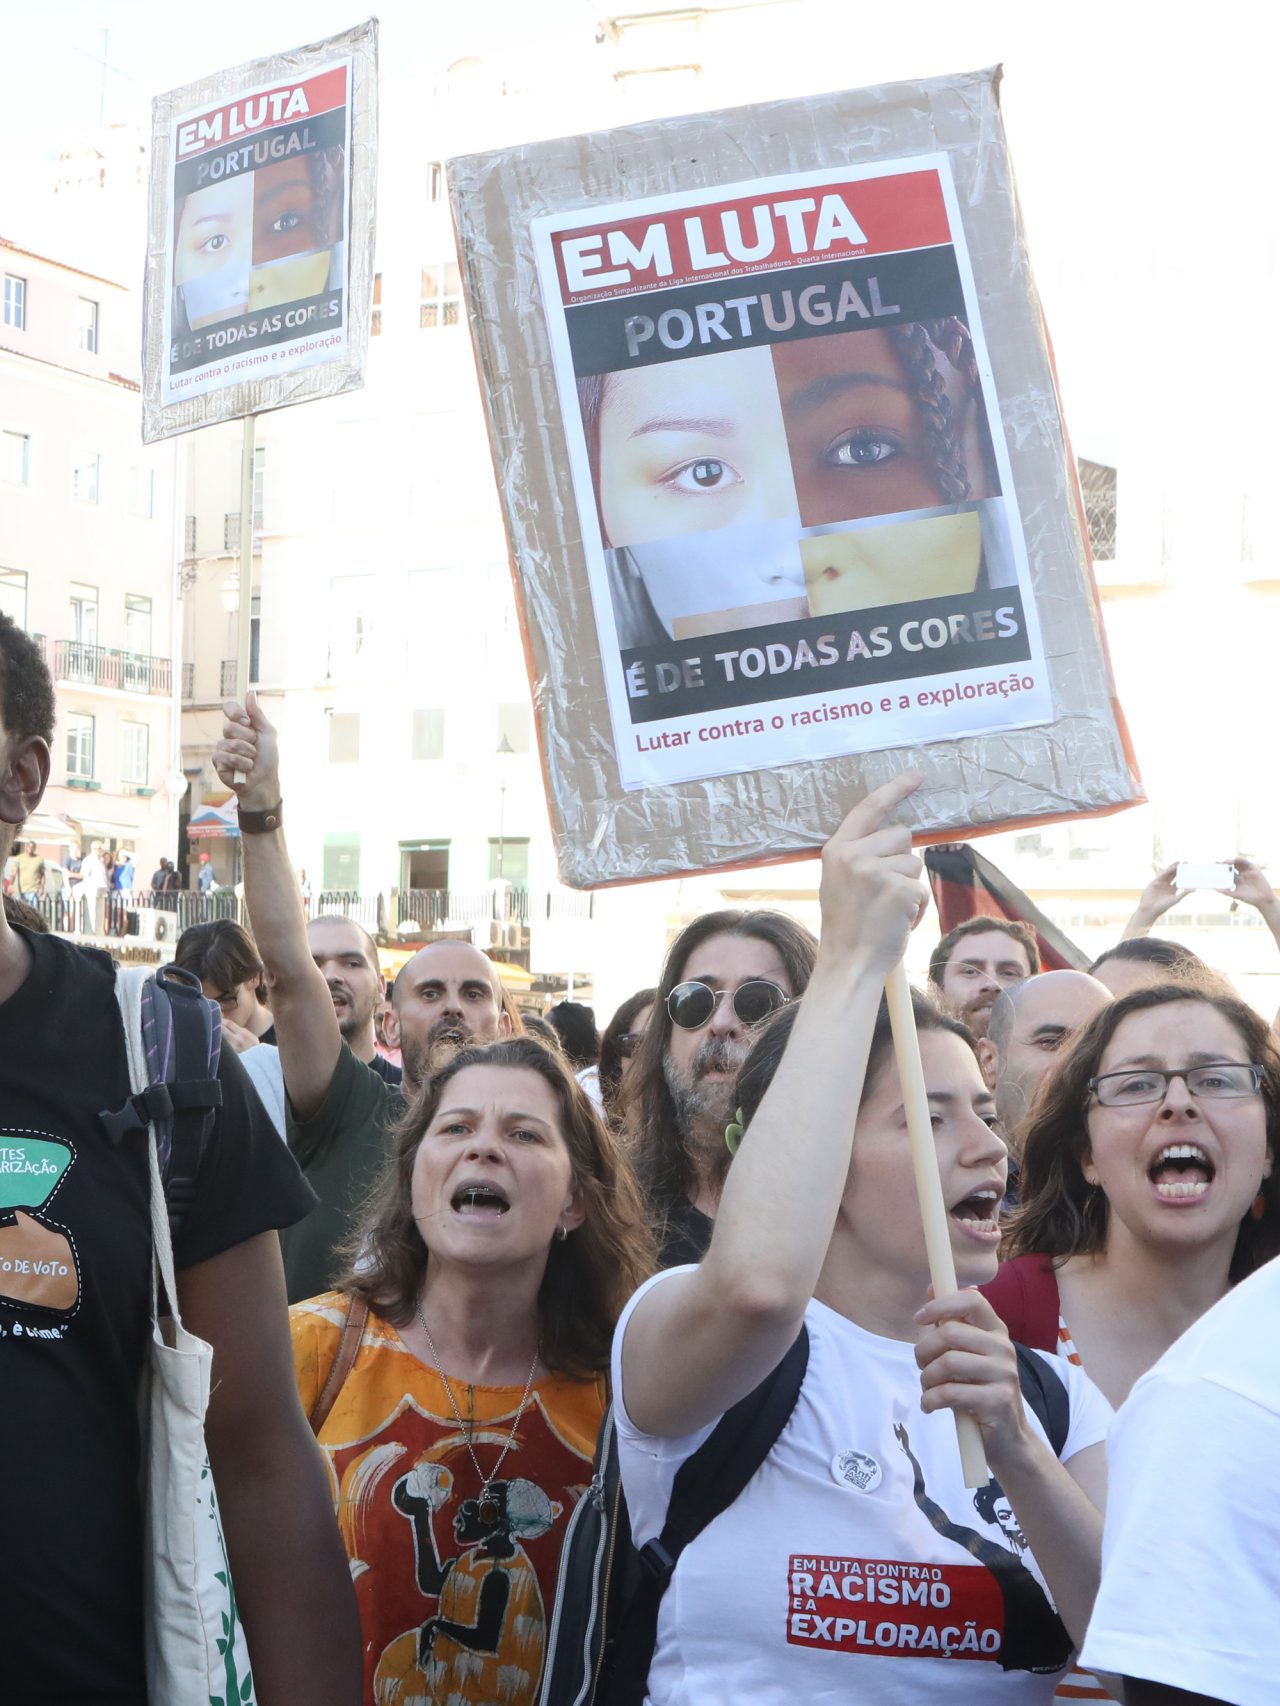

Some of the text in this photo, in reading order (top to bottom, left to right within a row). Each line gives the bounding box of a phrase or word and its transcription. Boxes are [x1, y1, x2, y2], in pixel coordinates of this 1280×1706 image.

[178, 112, 223, 155] EM
[229, 88, 309, 136] LUTA
[197, 128, 316, 185] PORTUGAL
[561, 194, 868, 293] EM LUTA
[570, 289, 613, 303] Organização
[613, 283, 657, 296] Simpatizante
[659, 279, 667, 287] da
[669, 276, 684, 287] Liga
[685, 269, 730, 282] Internacional
[731, 267, 744, 275] dos
[745, 259, 791, 273] Trabalhadores
[796, 255, 820, 266] Quarta
[821, 248, 866, 260] Internacional
[171, 343, 179, 363] É
[206, 320, 258, 350] TODAS
[260, 314, 281, 335] AS
[285, 299, 339, 328] CORES
[624, 276, 901, 356] PORTUGAL
[170, 334, 341, 390] Lutar contra o racismo e a exploração
[626, 606, 1019, 698] É DE TODAS AS CORES
[636, 673, 1035, 753] Lutar contra o racismo e a exploração
[15, 1259, 30, 1274] DE
[33, 1260, 68, 1276] VOTO
[791, 1572, 951, 1609] RACISMO
[793, 1558, 942, 1581] EM LUTA CONTRA O
[793, 1597, 817, 1611] E A
[790, 1612, 1001, 1658] EXPLORAÇÃO
